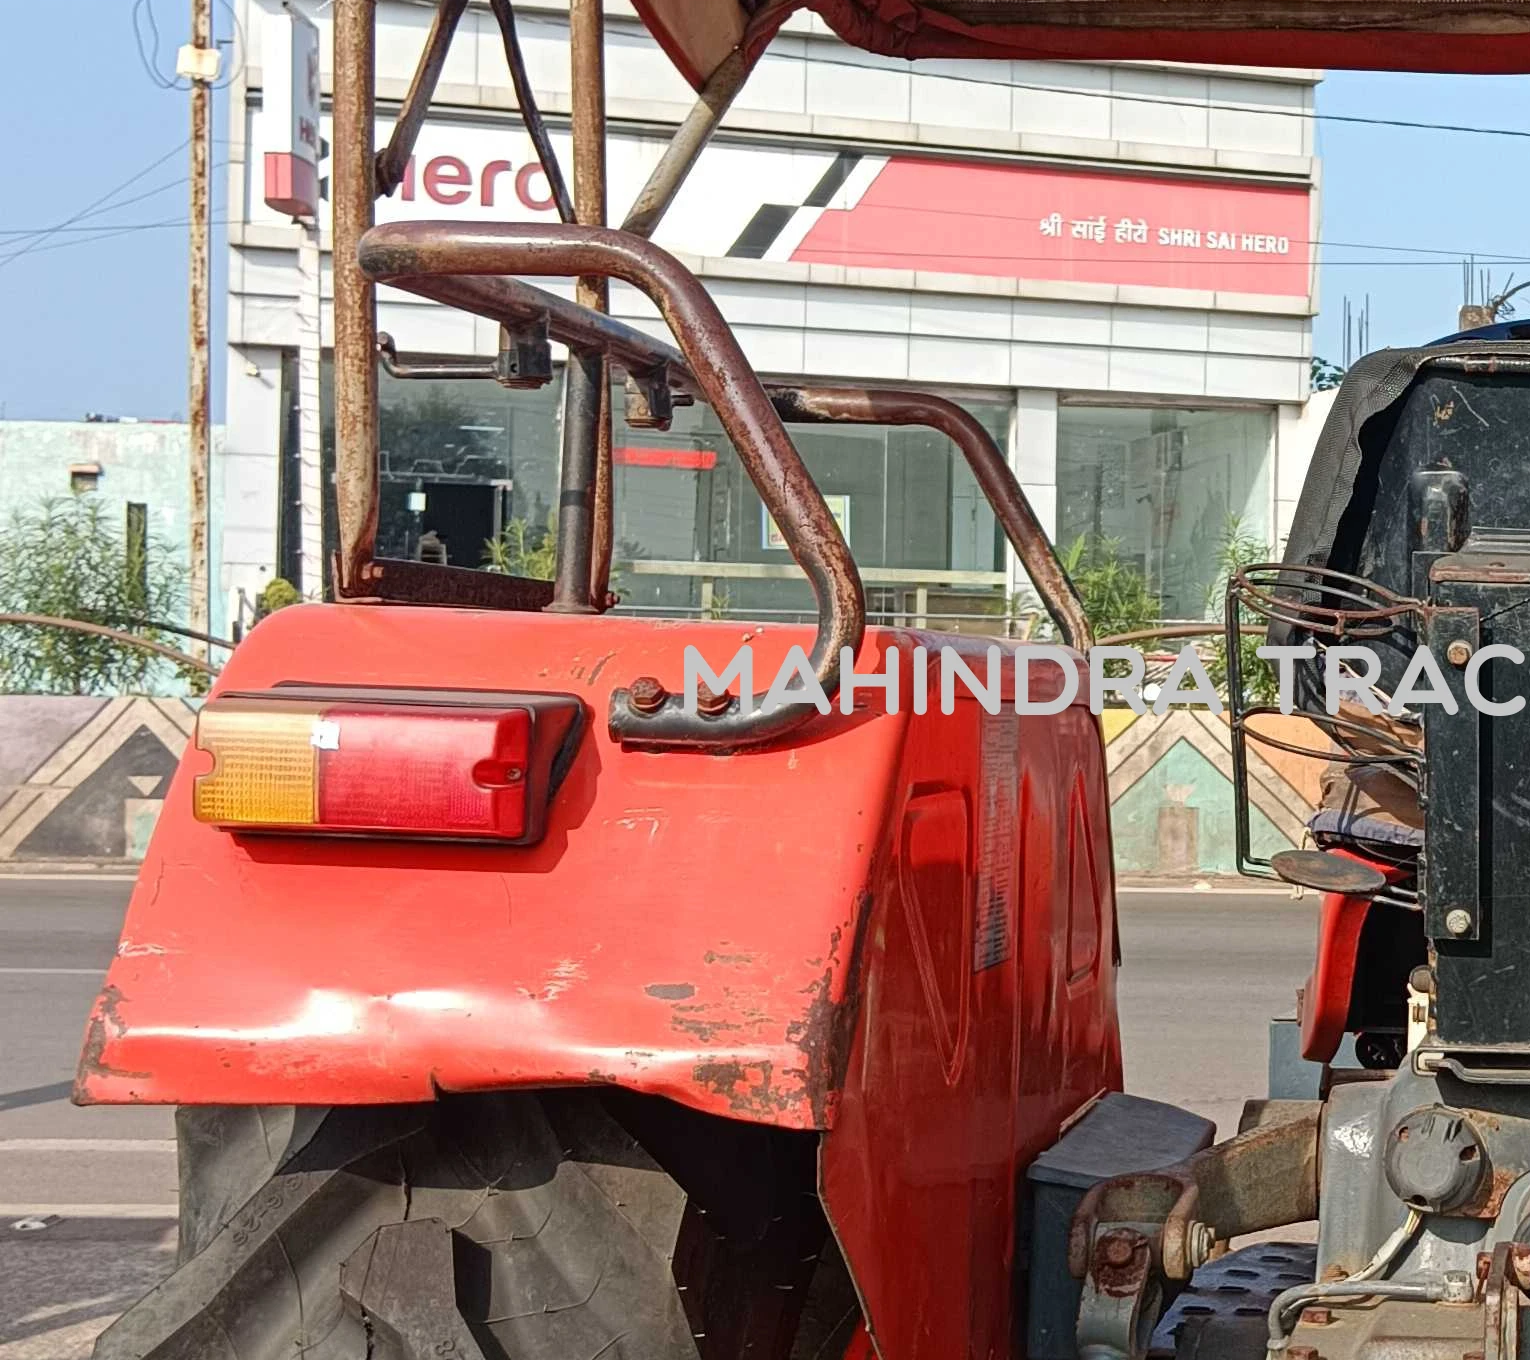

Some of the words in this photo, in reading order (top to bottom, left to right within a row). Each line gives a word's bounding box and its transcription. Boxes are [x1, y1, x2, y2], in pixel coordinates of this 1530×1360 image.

[1039, 212, 1063, 237] श्री
[1158, 227, 1201, 248] SHRI
[1206, 231, 1236, 251] SAI
[1241, 232, 1289, 254] HERO
